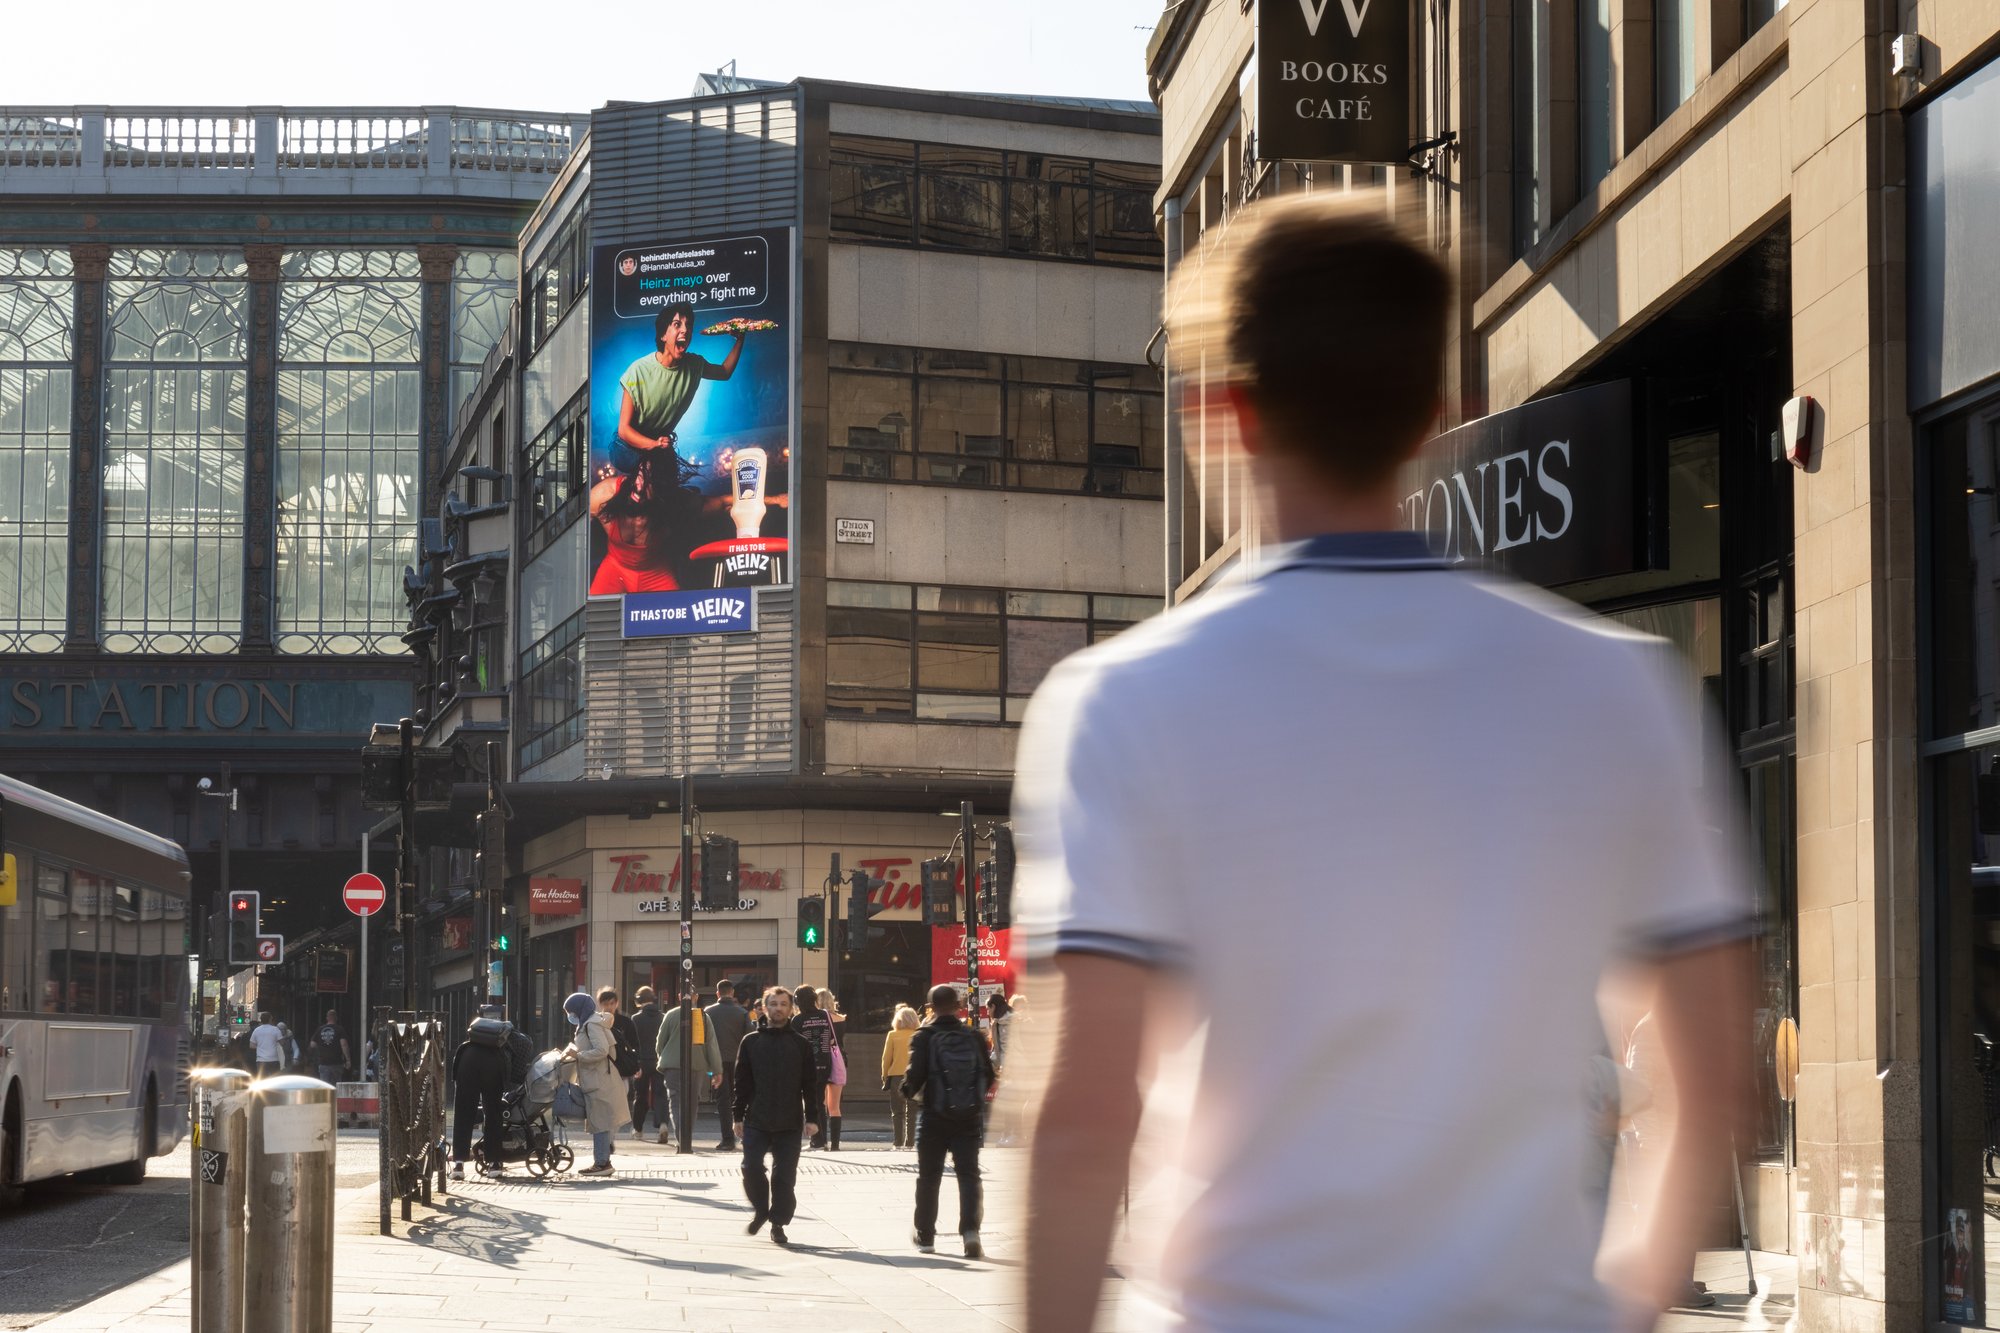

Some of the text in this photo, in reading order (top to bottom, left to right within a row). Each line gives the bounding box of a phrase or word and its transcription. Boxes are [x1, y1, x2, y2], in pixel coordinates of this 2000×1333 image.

[1281, 60, 1388, 85] BOOKS
[1295, 95, 1373, 121] CAFÉ
[640, 248, 715, 263] behindthefalselashes
[640, 258, 706, 272] @HannahLouisa_xo
[640, 271, 730, 290] Heinz mayo over
[640, 291, 697, 306] everything
[710, 286, 735, 301] fight
[738, 286, 756, 296] me
[1397, 439, 1574, 564] TONES
[842, 521, 869, 529] UNION
[838, 529, 872, 538] STREET
[729, 543, 766, 553] IT HAS TO BE
[726, 553, 769, 573] HEINZ
[631, 607, 687, 621] IT HAS TO BE
[691, 597, 745, 621] HEINZ
[11, 679, 299, 729] STATION
[609, 854, 663, 893] Tim
[532, 888, 579, 899] Tim Hortons
[672, 900, 681, 912] &
[977, 949, 1000, 957] DEALS
[948, 958, 966, 966] Grab
[987, 959, 1007, 968] today
